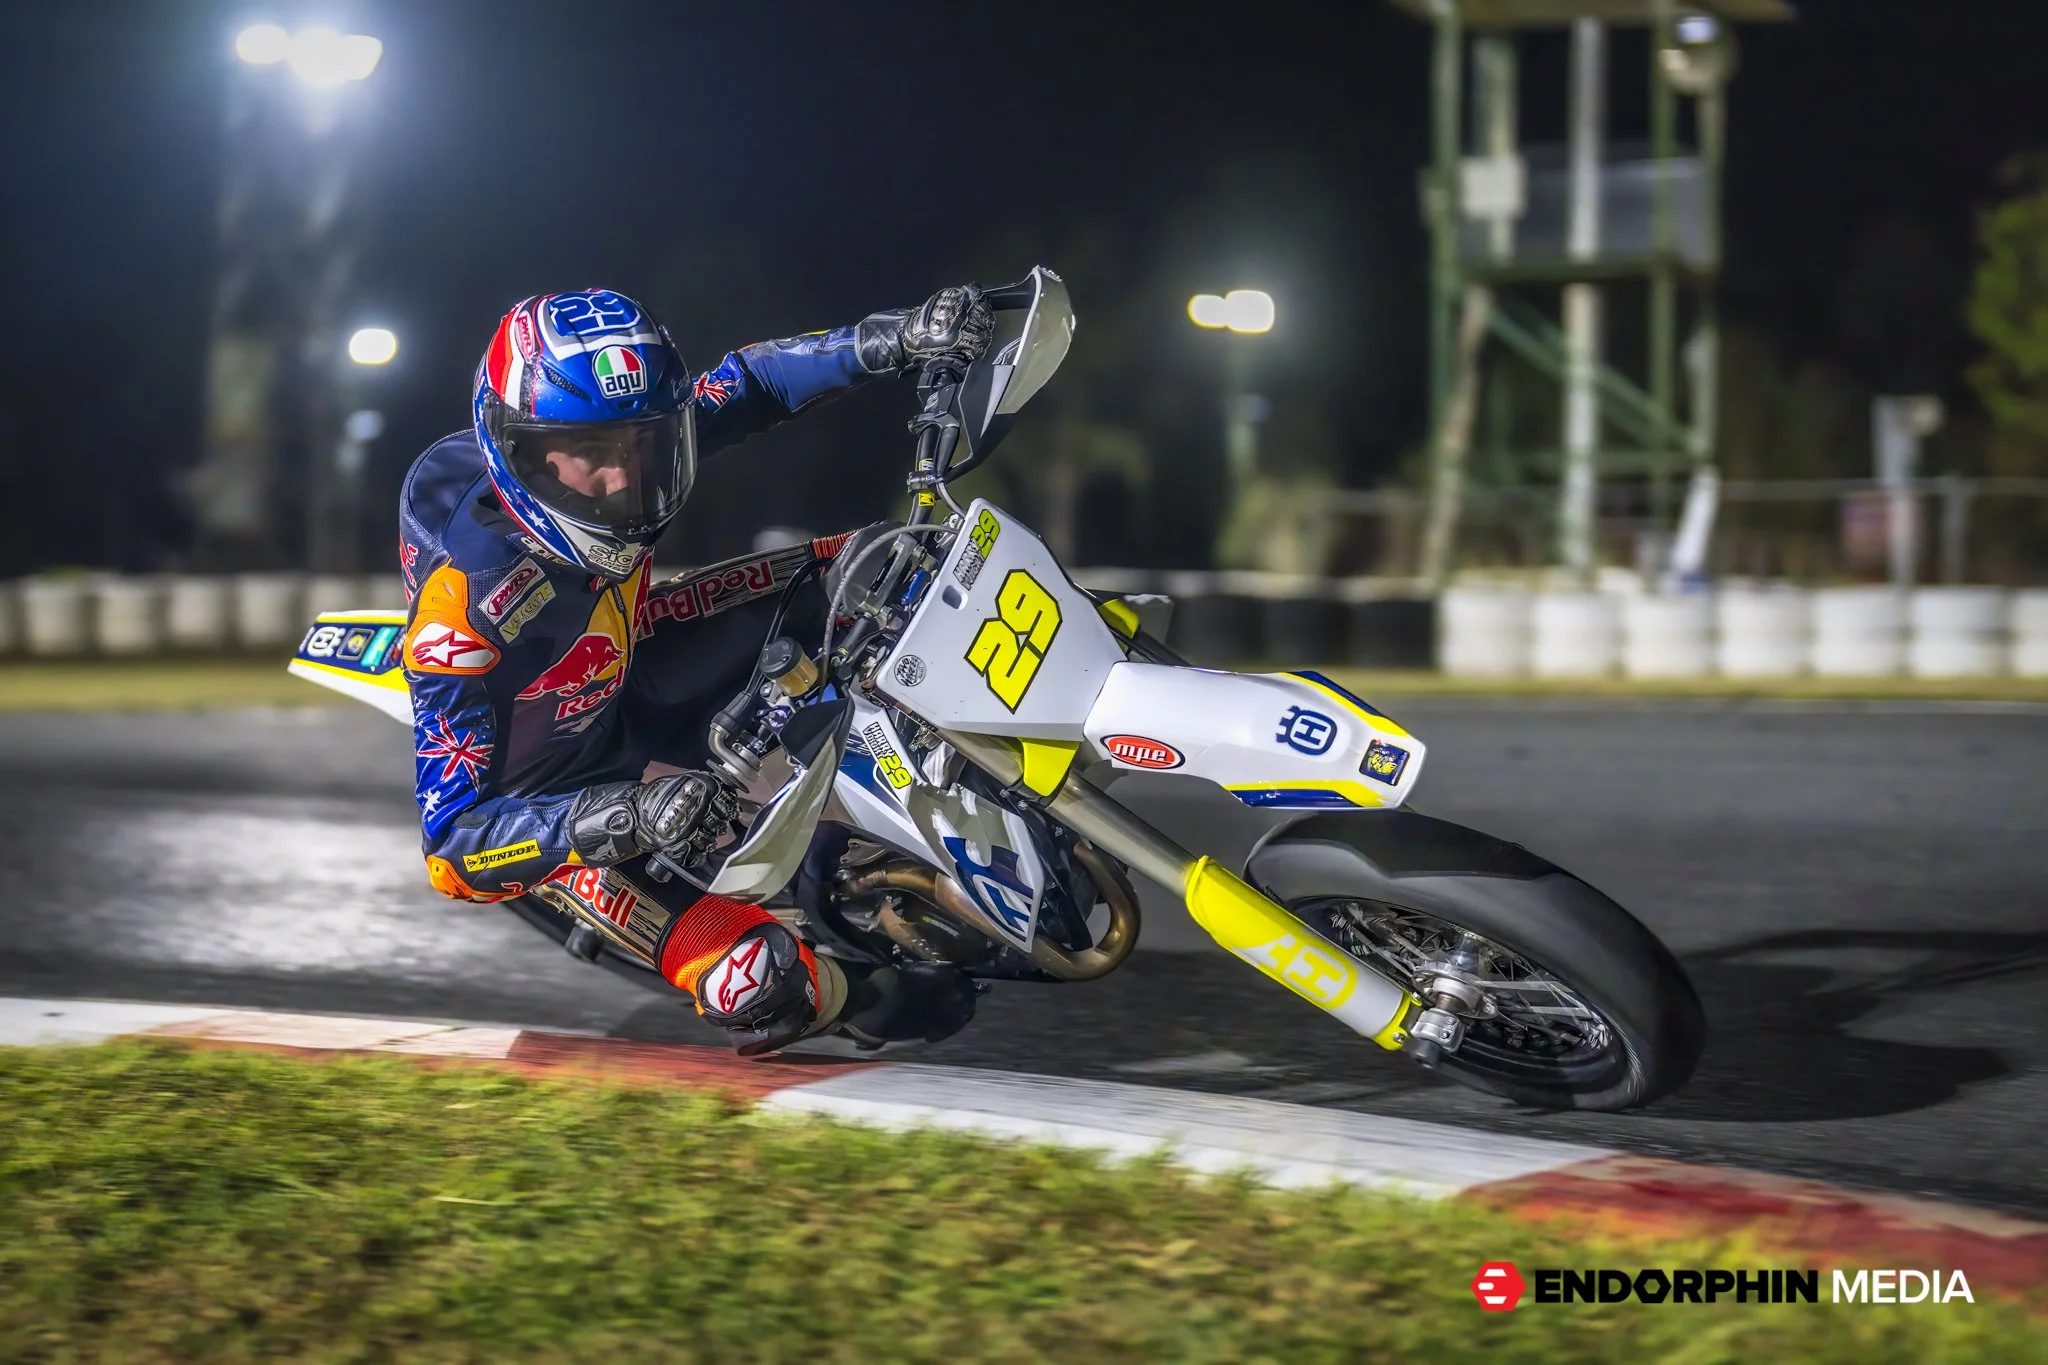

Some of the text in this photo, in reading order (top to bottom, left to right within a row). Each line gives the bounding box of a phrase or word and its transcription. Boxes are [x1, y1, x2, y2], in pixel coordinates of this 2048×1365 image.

[605, 371, 640, 394] agv
[970, 509, 1000, 561] 29
[697, 560, 775, 617] Red
[964, 569, 1063, 714] 29
[555, 665, 625, 720] Red
[878, 750, 913, 789] 29
[479, 844, 537, 865] DUNLOP
[573, 868, 639, 929] Bull
